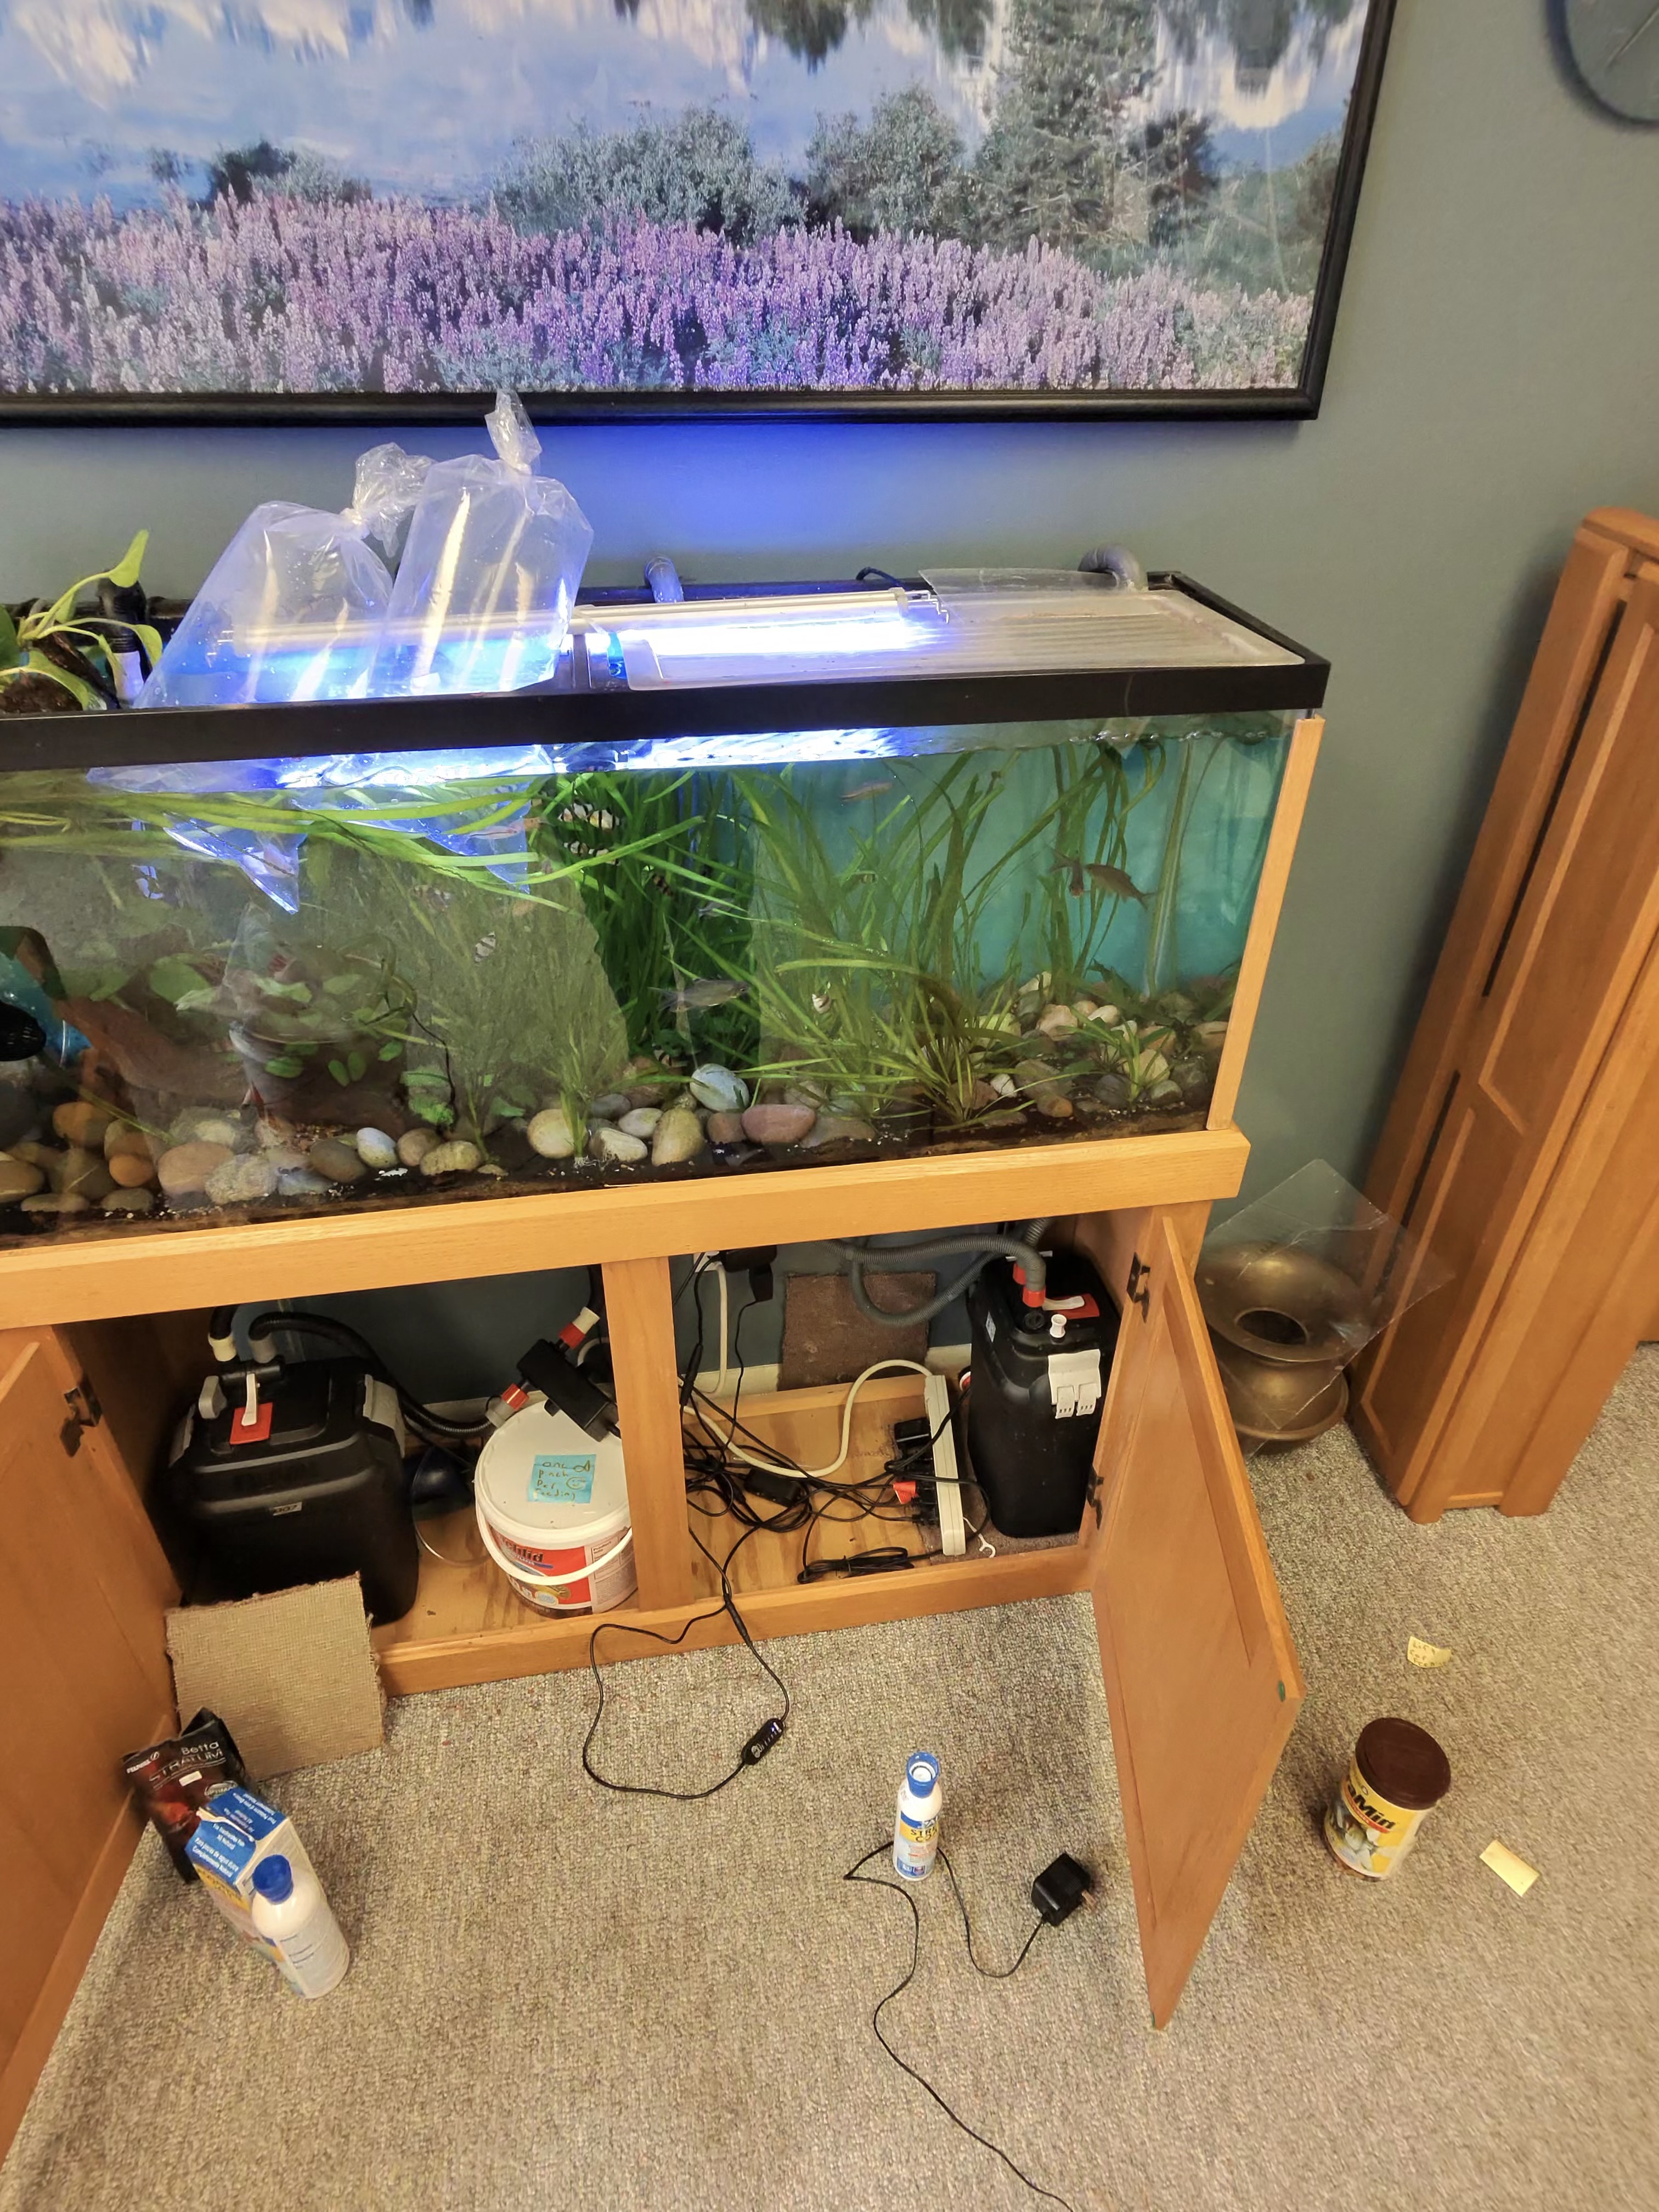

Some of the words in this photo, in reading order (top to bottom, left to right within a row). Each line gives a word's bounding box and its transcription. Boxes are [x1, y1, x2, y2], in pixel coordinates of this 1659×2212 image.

[539, 1469, 568, 1479] pnch
[181, 1741, 219, 1755] Betta
[149, 1748, 224, 1781] STRATUM
